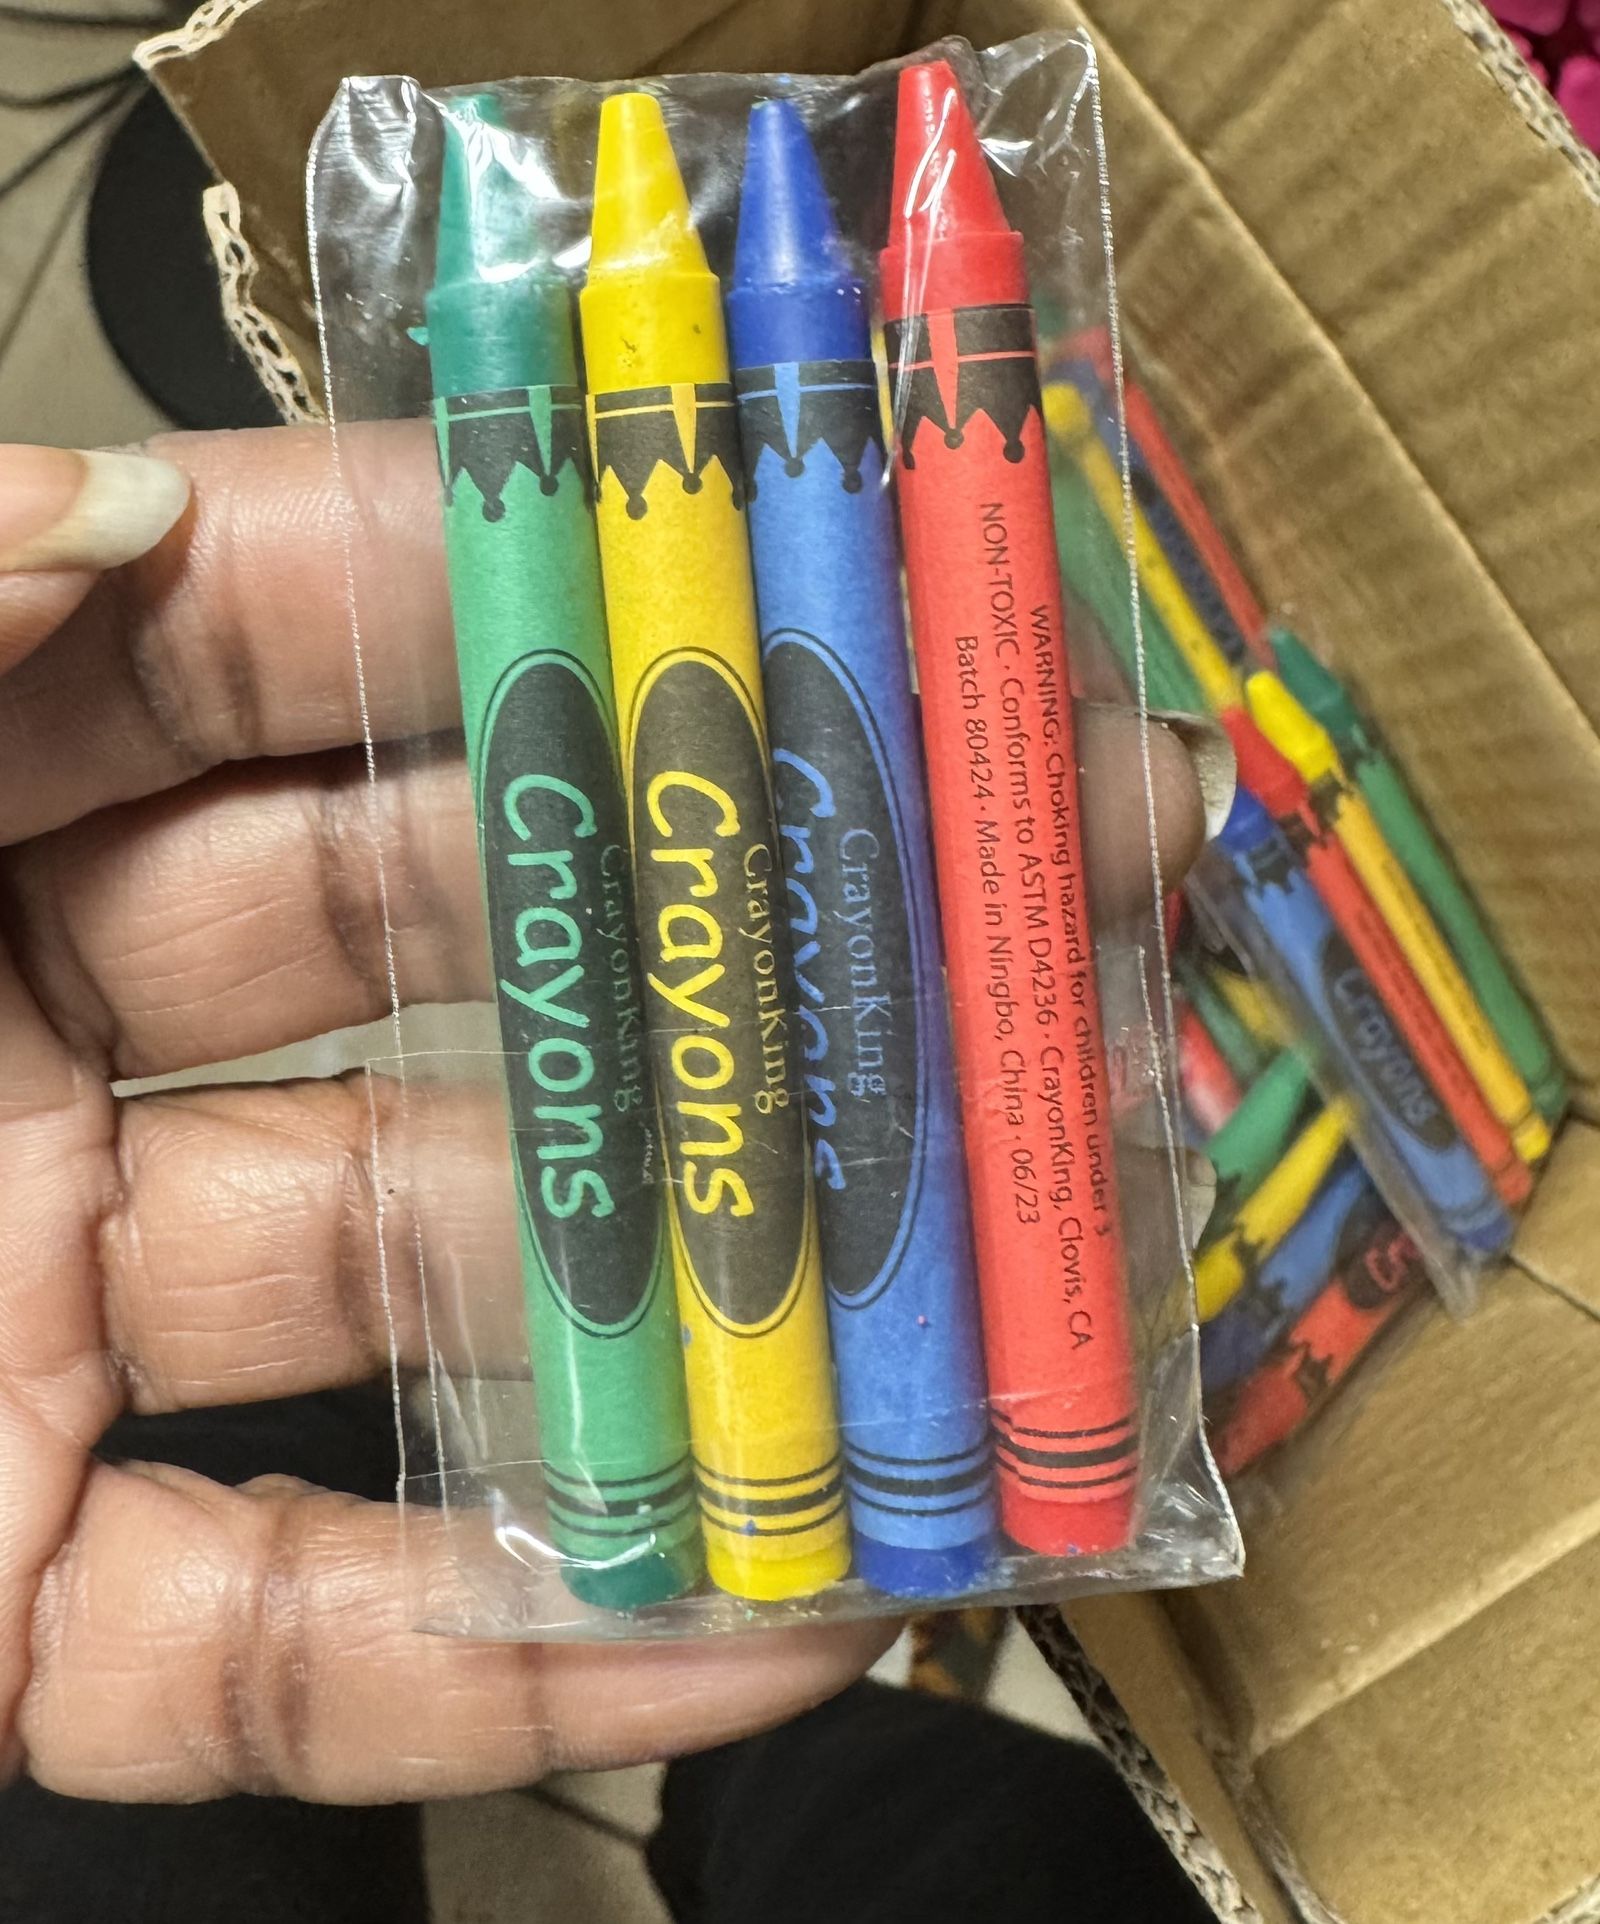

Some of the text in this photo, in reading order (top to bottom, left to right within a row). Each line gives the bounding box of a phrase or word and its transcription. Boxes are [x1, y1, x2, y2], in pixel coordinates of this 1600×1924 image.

[1029, 603, 1061, 747] WARNING:
[1046, 752, 1071, 867] Choking
[501, 773, 616, 1218] Crayons
[646, 770, 755, 1217] Crayons
[737, 843, 791, 1115] CrayonKing
[832, 828, 893, 1099] CrayonKing
[954, 635, 1041, 1226] Batch 80424 Made in Ningbo, China 06/23
[979, 501, 1094, 1351] NON-TOXIC Conforms to ASTM D4236 CrayonKing, Clovis, CA
[1057, 872, 1086, 965] hazard
[1069, 970, 1088, 1006] for
[1075, 1014, 1100, 1127] children
[1085, 1133, 1109, 1213] under
